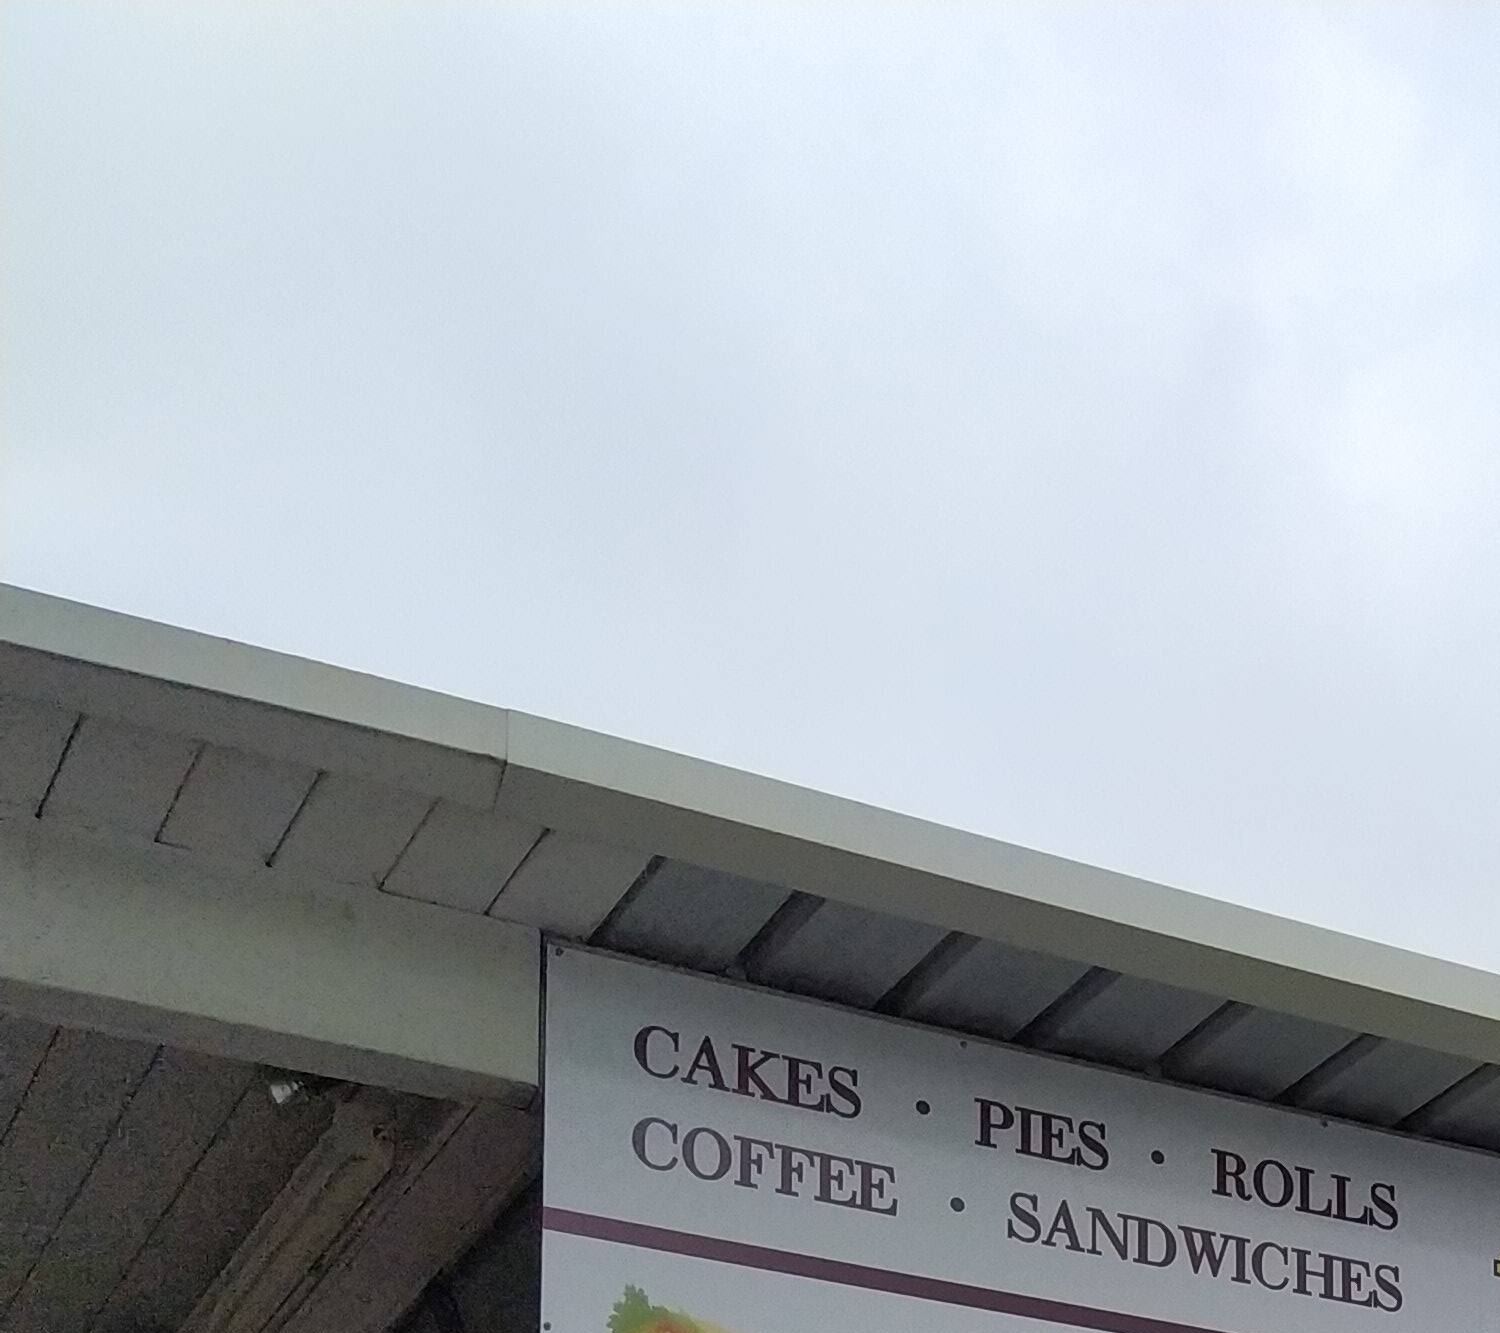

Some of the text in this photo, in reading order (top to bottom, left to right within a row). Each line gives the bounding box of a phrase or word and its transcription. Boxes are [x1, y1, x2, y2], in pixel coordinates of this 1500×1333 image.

[631, 1116, 1403, 1313] COFFEE SANDWICHES
[633, 1024, 1399, 1231] CAKES PIES ROLLS
